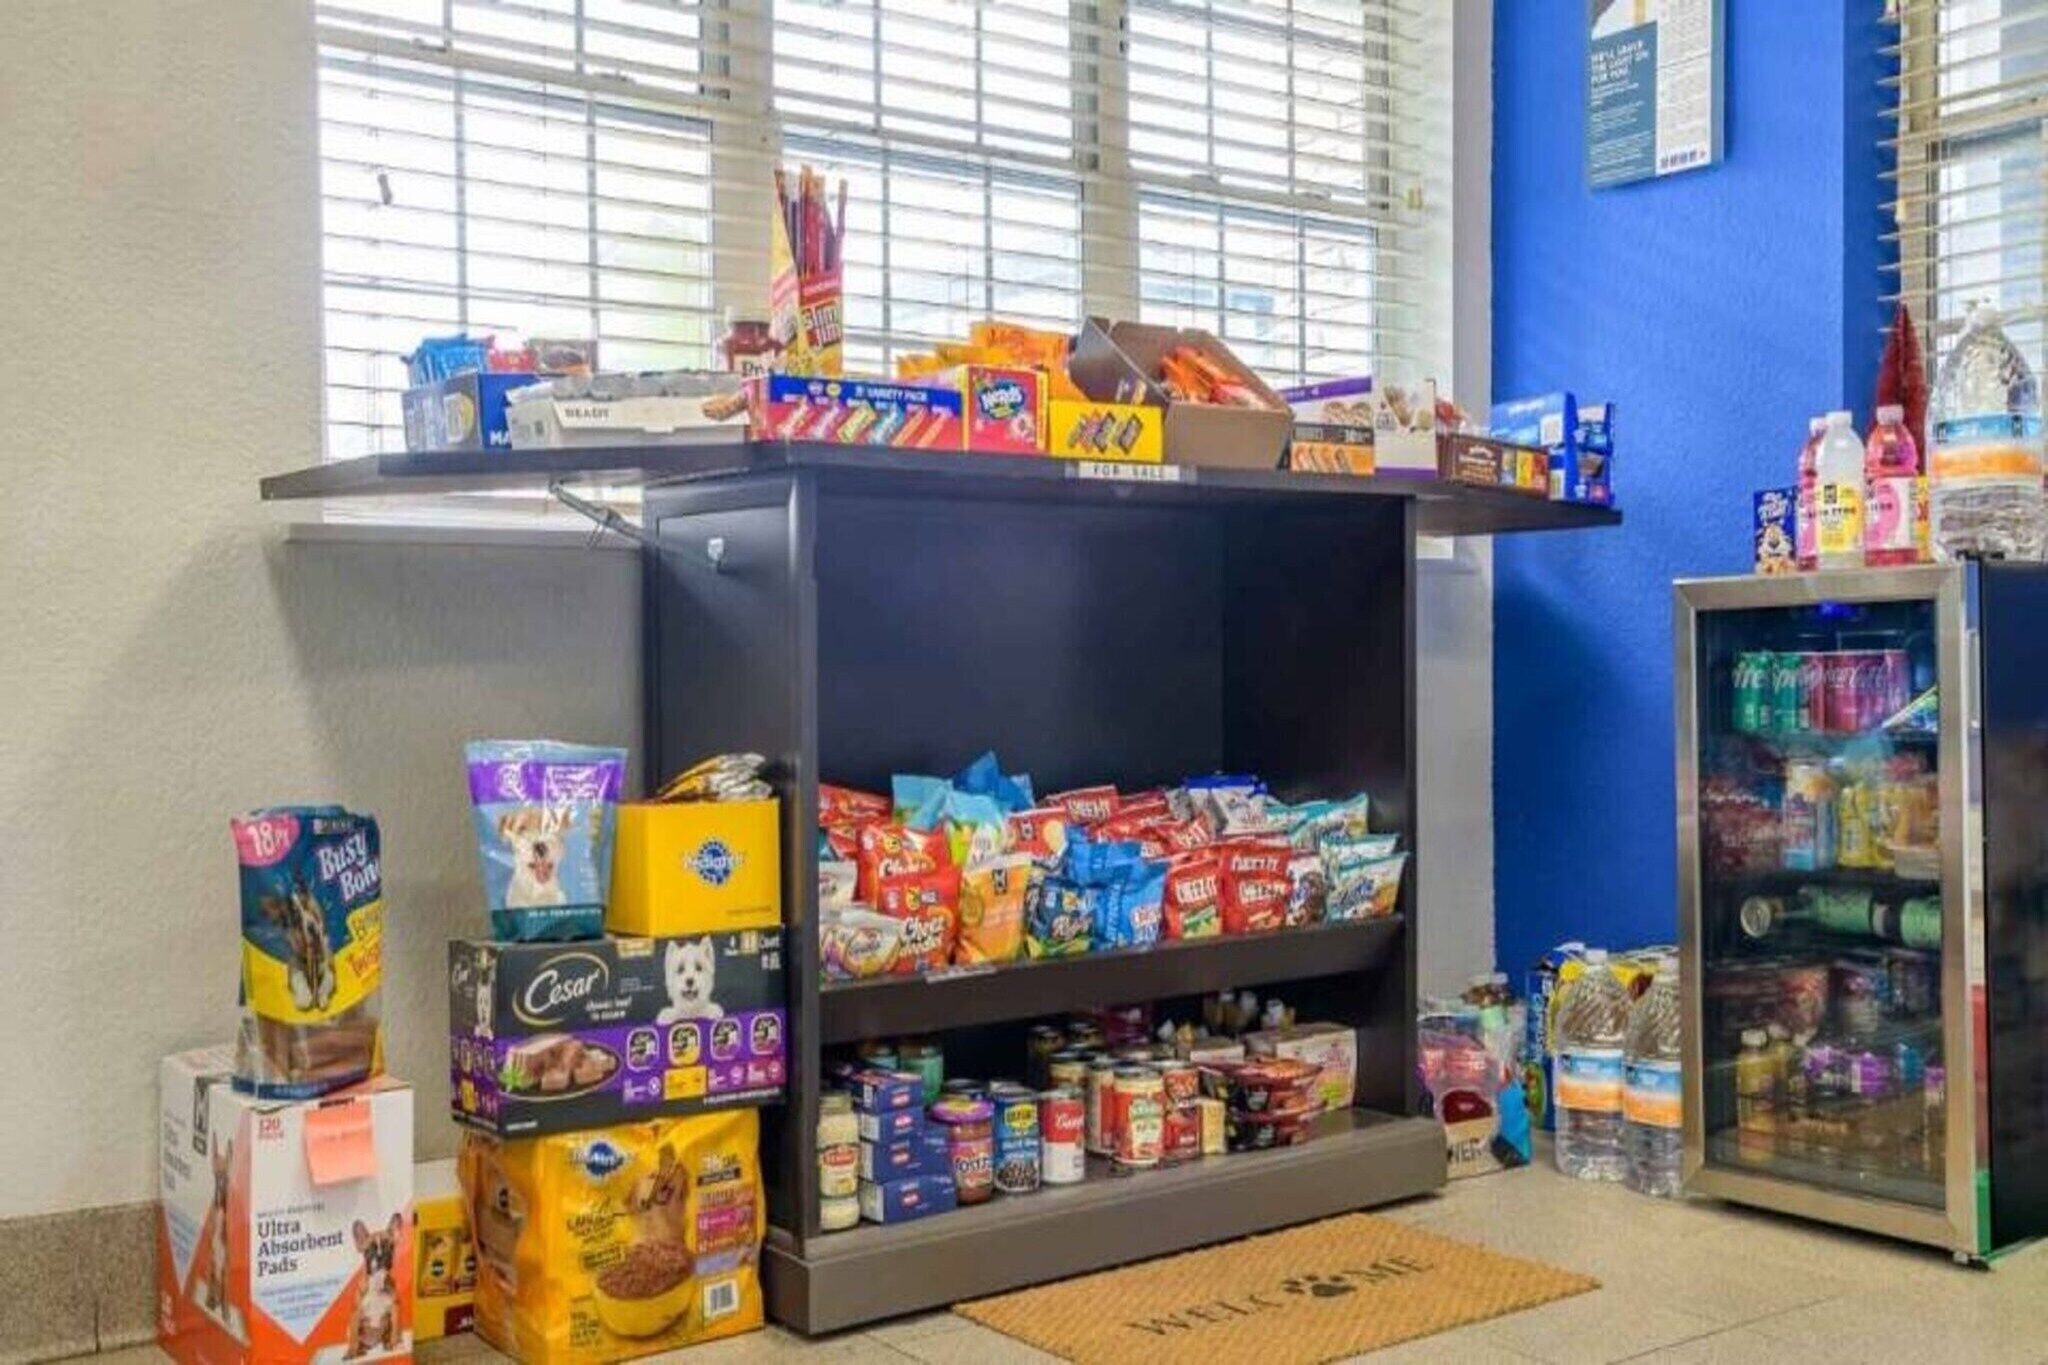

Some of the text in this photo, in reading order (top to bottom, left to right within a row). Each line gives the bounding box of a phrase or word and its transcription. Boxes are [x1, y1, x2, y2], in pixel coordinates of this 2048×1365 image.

[316, 828, 368, 882] Busy
[523, 966, 602, 1015] Cesar
[257, 1218, 301, 1239] Ultra
[256, 1230, 344, 1258] Absorbent
[257, 1257, 299, 1279] Pads
